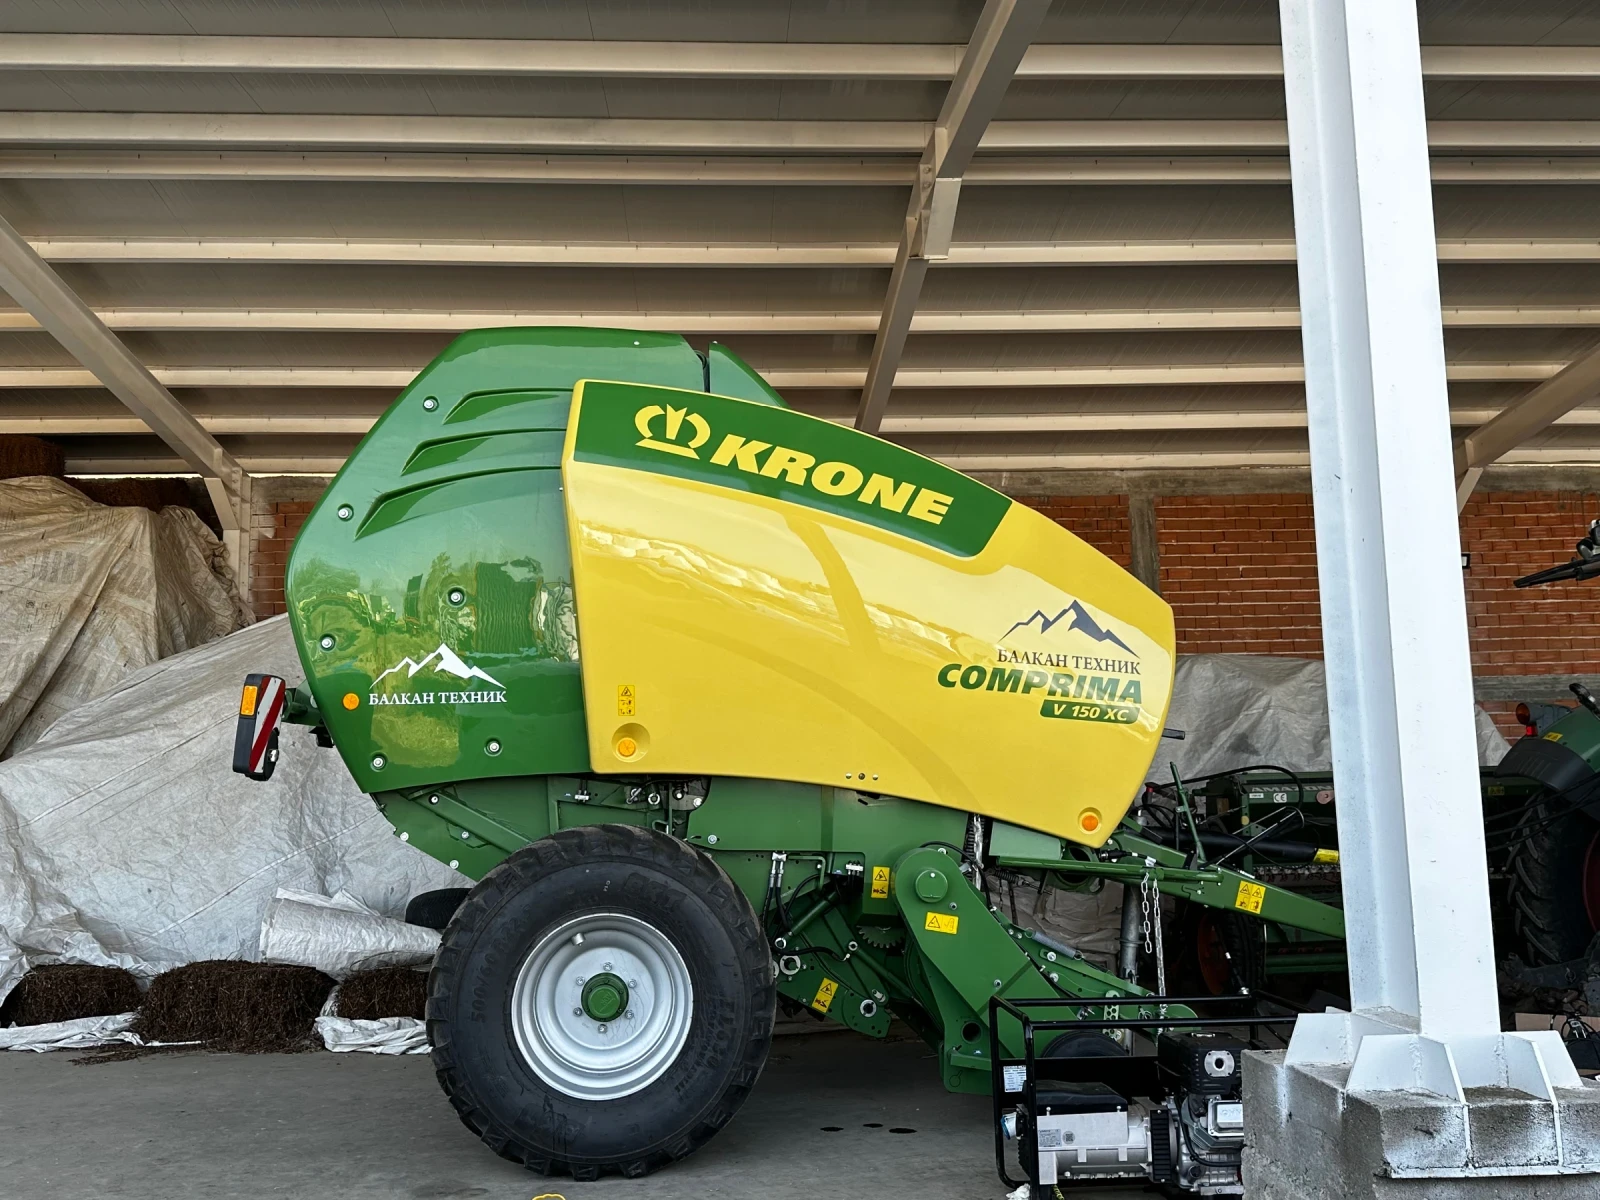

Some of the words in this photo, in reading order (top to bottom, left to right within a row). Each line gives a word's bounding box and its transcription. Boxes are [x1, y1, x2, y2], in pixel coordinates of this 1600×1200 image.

[710, 434, 954, 524] KRONE
[997, 648, 1068, 667] БАЛКАН
[1072, 655, 1141, 675] ТЕХНИК
[937, 663, 1142, 705] COMPRIMA
[368, 692, 435, 705] БАЛКАН
[438, 691, 507, 703] ТЕХНИК
[1053, 704, 1067, 716] V
[1071, 705, 1100, 718] 150
[1104, 708, 1130, 721] XC
[1274, 793, 1287, 803] CE
